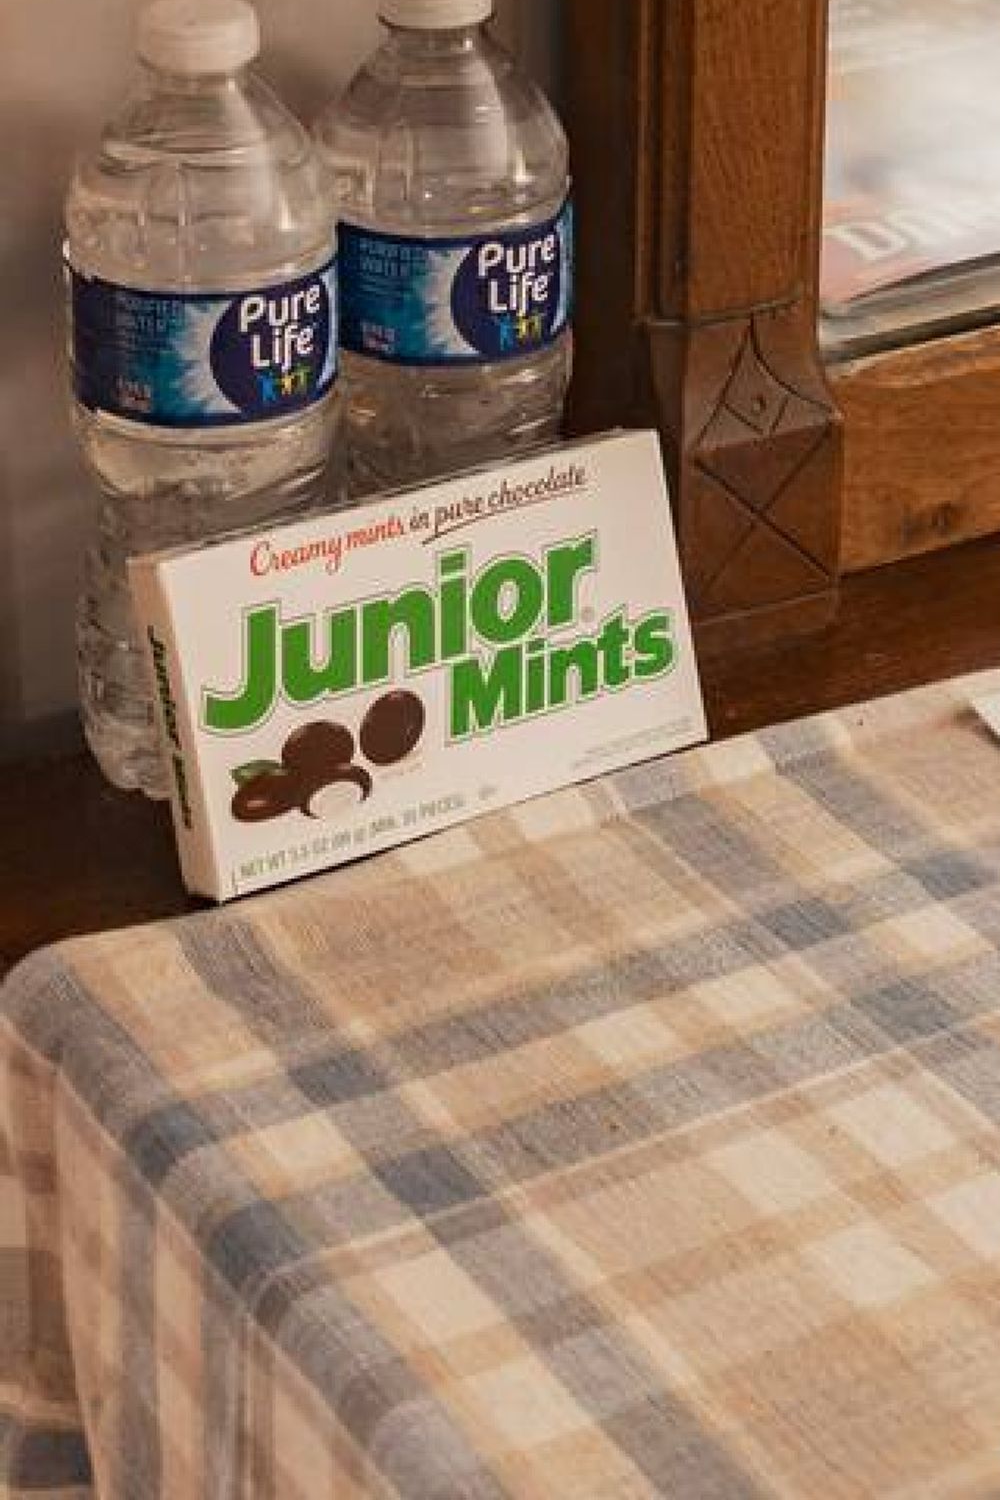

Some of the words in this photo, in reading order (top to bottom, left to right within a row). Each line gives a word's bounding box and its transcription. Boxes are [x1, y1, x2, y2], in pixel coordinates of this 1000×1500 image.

[477, 232, 556, 277] Pure
[239, 284, 321, 333] Pure
[488, 269, 550, 316] Life
[251, 324, 313, 373] Life
[250, 534, 343, 576] Creamy
[346, 514, 406, 550] mints
[409, 506, 431, 532] in
[433, 491, 484, 534] pure
[487, 464, 588, 512] chocolate
[199, 530, 599, 736] Junior
[448, 607, 680, 745] Mints
